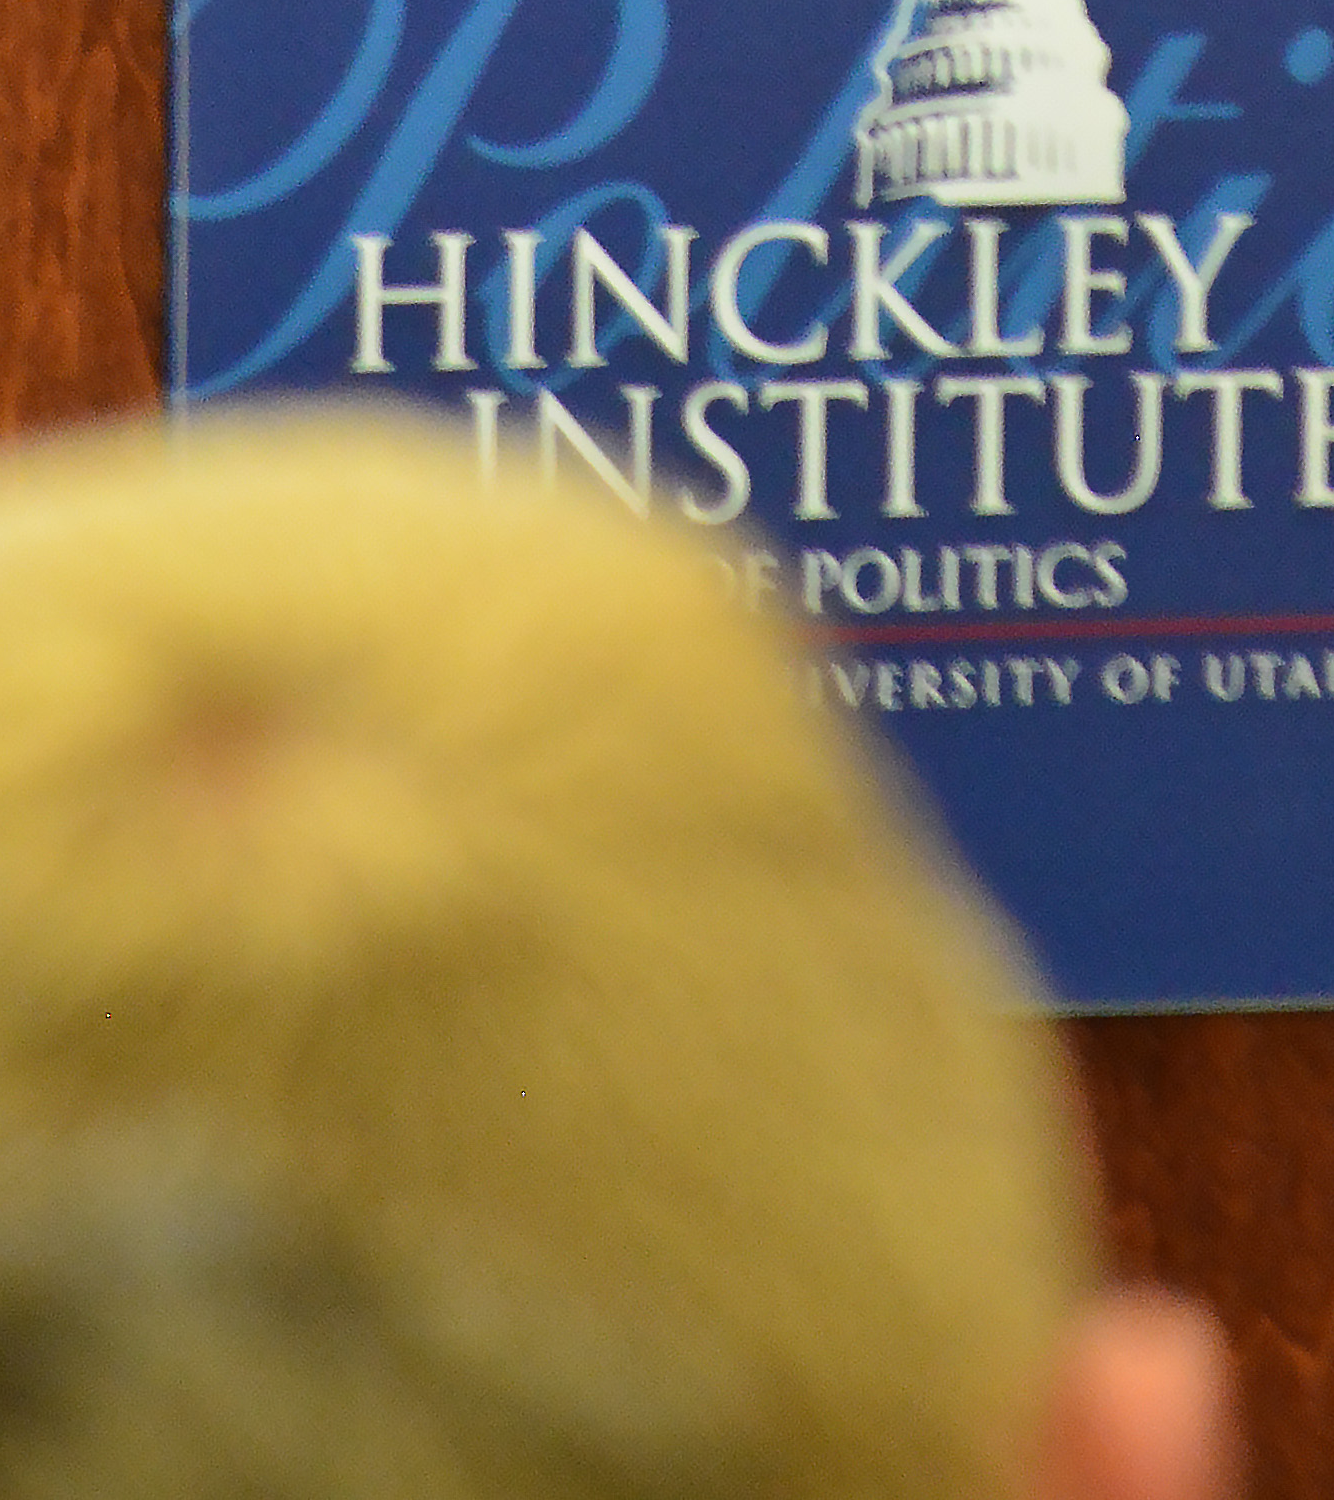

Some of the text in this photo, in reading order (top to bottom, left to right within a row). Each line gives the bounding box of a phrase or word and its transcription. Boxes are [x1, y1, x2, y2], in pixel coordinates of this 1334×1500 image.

[349, 212, 1259, 376] HINCKLEY
[802, 541, 1129, 614] POLITICS
[1100, 653, 1183, 704] OF
